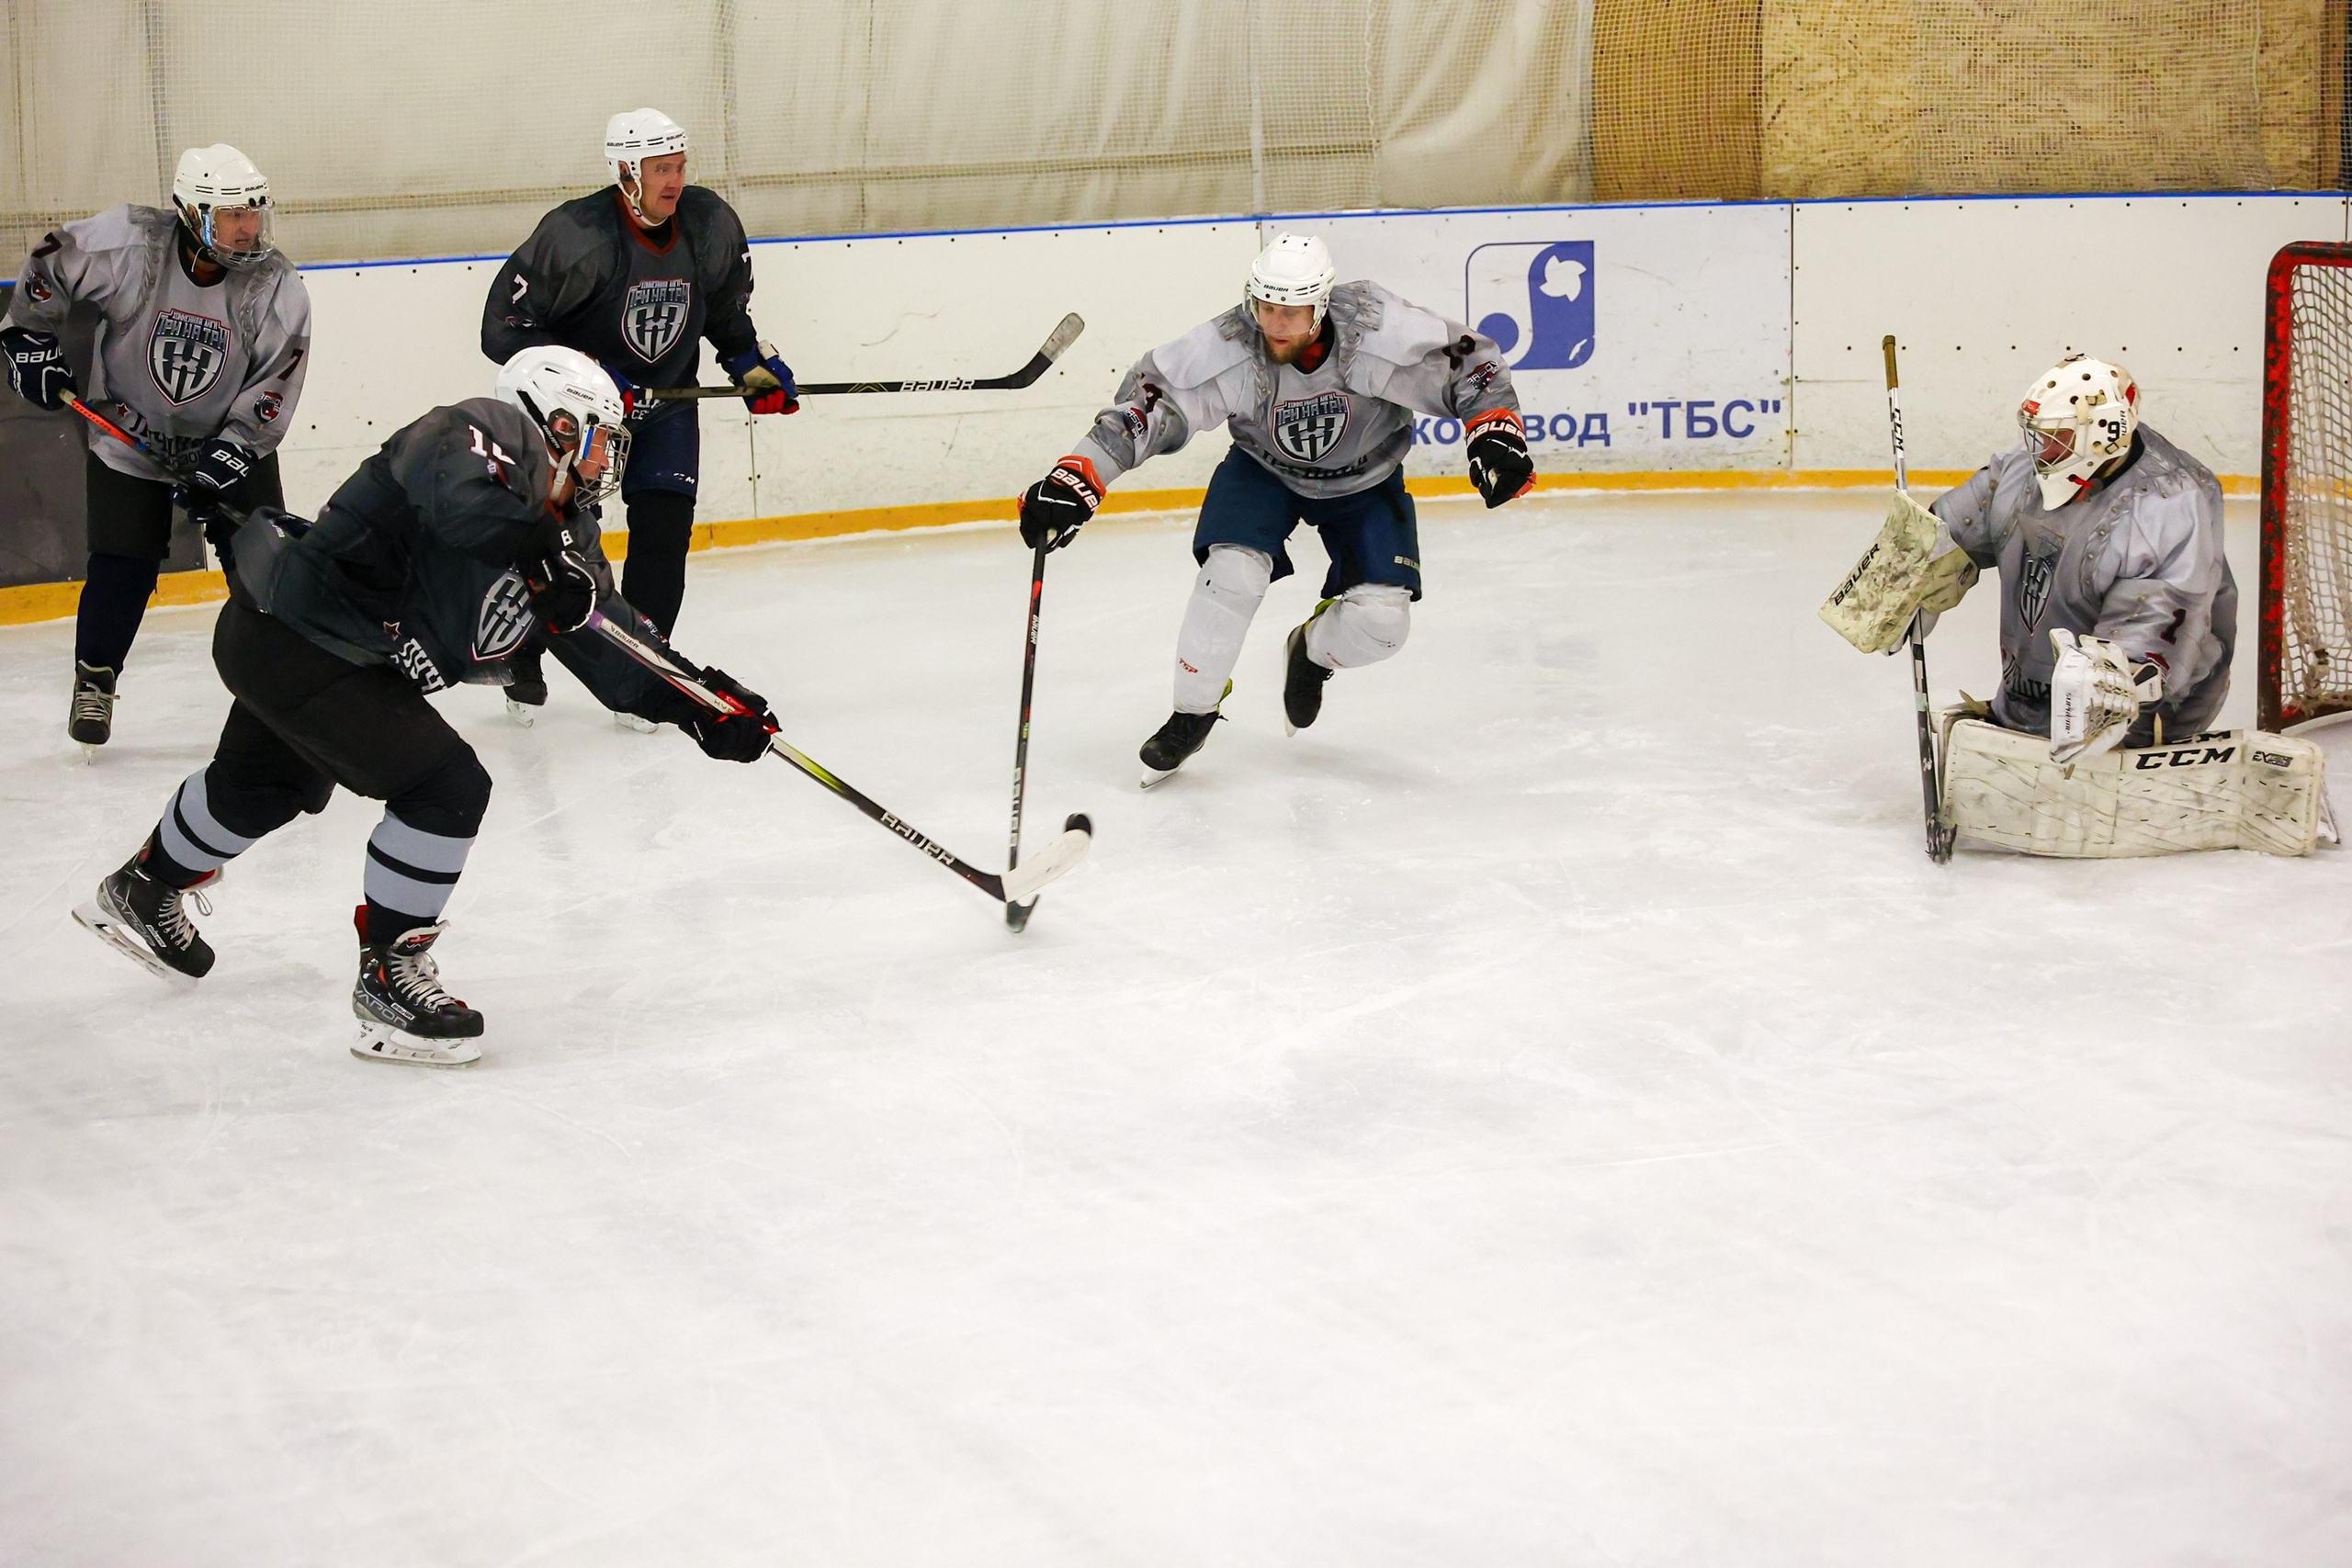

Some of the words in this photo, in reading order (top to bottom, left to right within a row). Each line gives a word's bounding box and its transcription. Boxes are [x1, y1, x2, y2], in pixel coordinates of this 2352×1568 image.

[182, 321, 202, 341] НА
[566, 387, 594, 402] BAUER
[899, 378, 976, 393] BAUER
[1276, 407, 1299, 426] ТРИ
[1300, 403, 1319, 419] НА
[1835, 543, 1881, 606] BAUER
[2135, 746, 2236, 771] CCM
